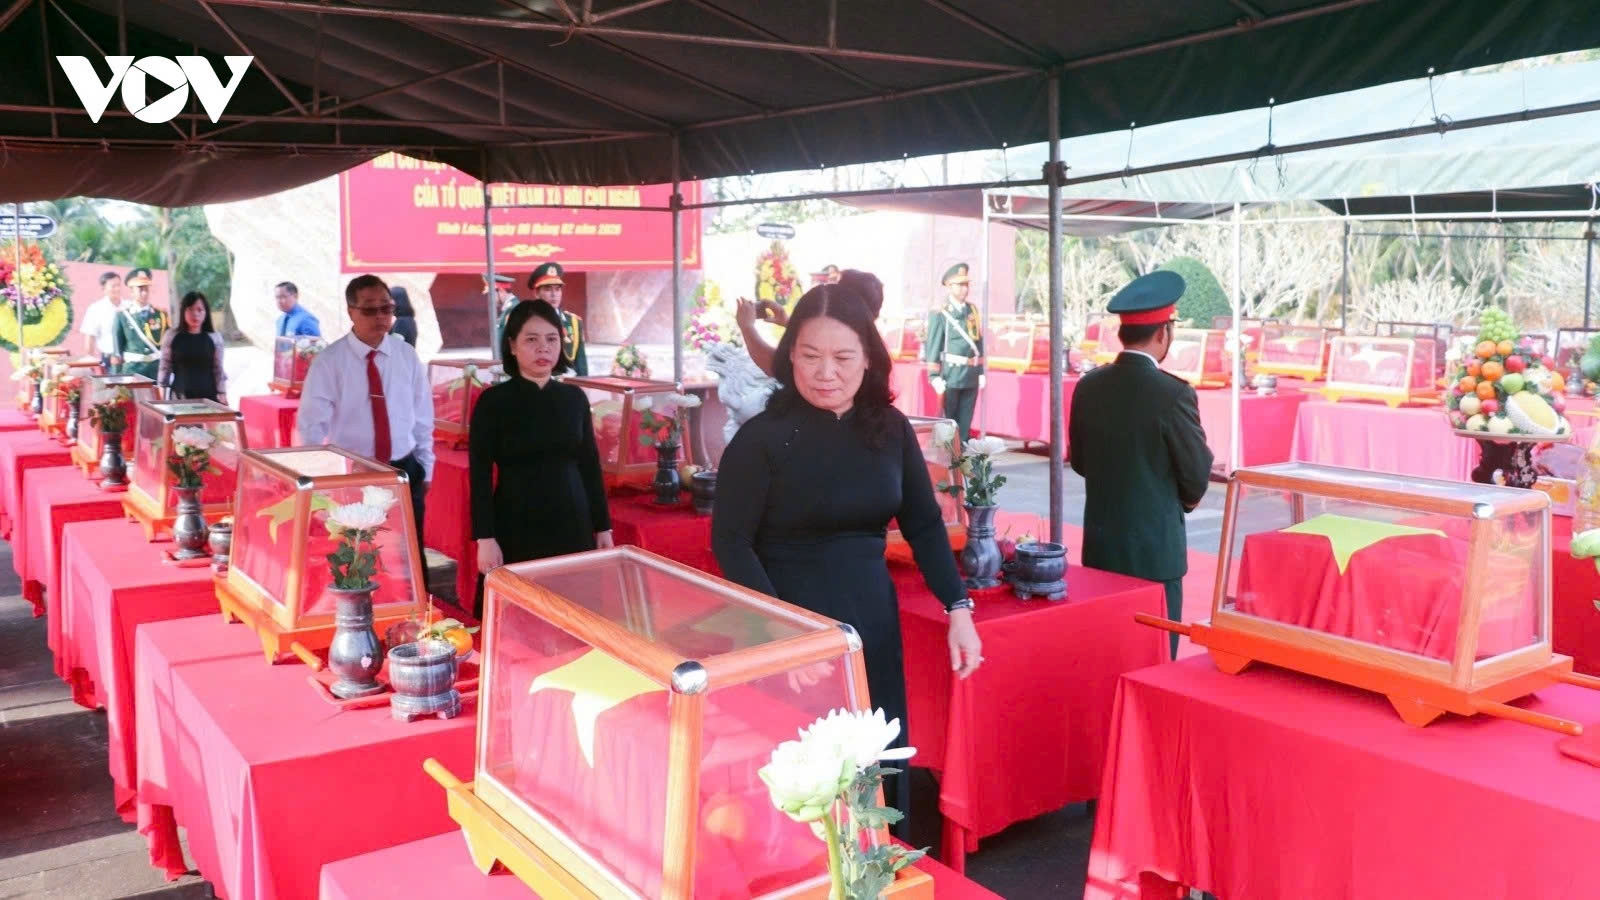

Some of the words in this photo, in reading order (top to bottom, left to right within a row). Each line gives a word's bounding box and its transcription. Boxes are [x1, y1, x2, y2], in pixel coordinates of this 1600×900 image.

[413, 177, 440, 208] CỦA
[490, 182, 516, 213] VIỆT
[517, 187, 545, 206] NAM
[563, 185, 583, 214] HỘI
[608, 185, 641, 207] NGHĨA
[531, 222, 560, 236] tháng
